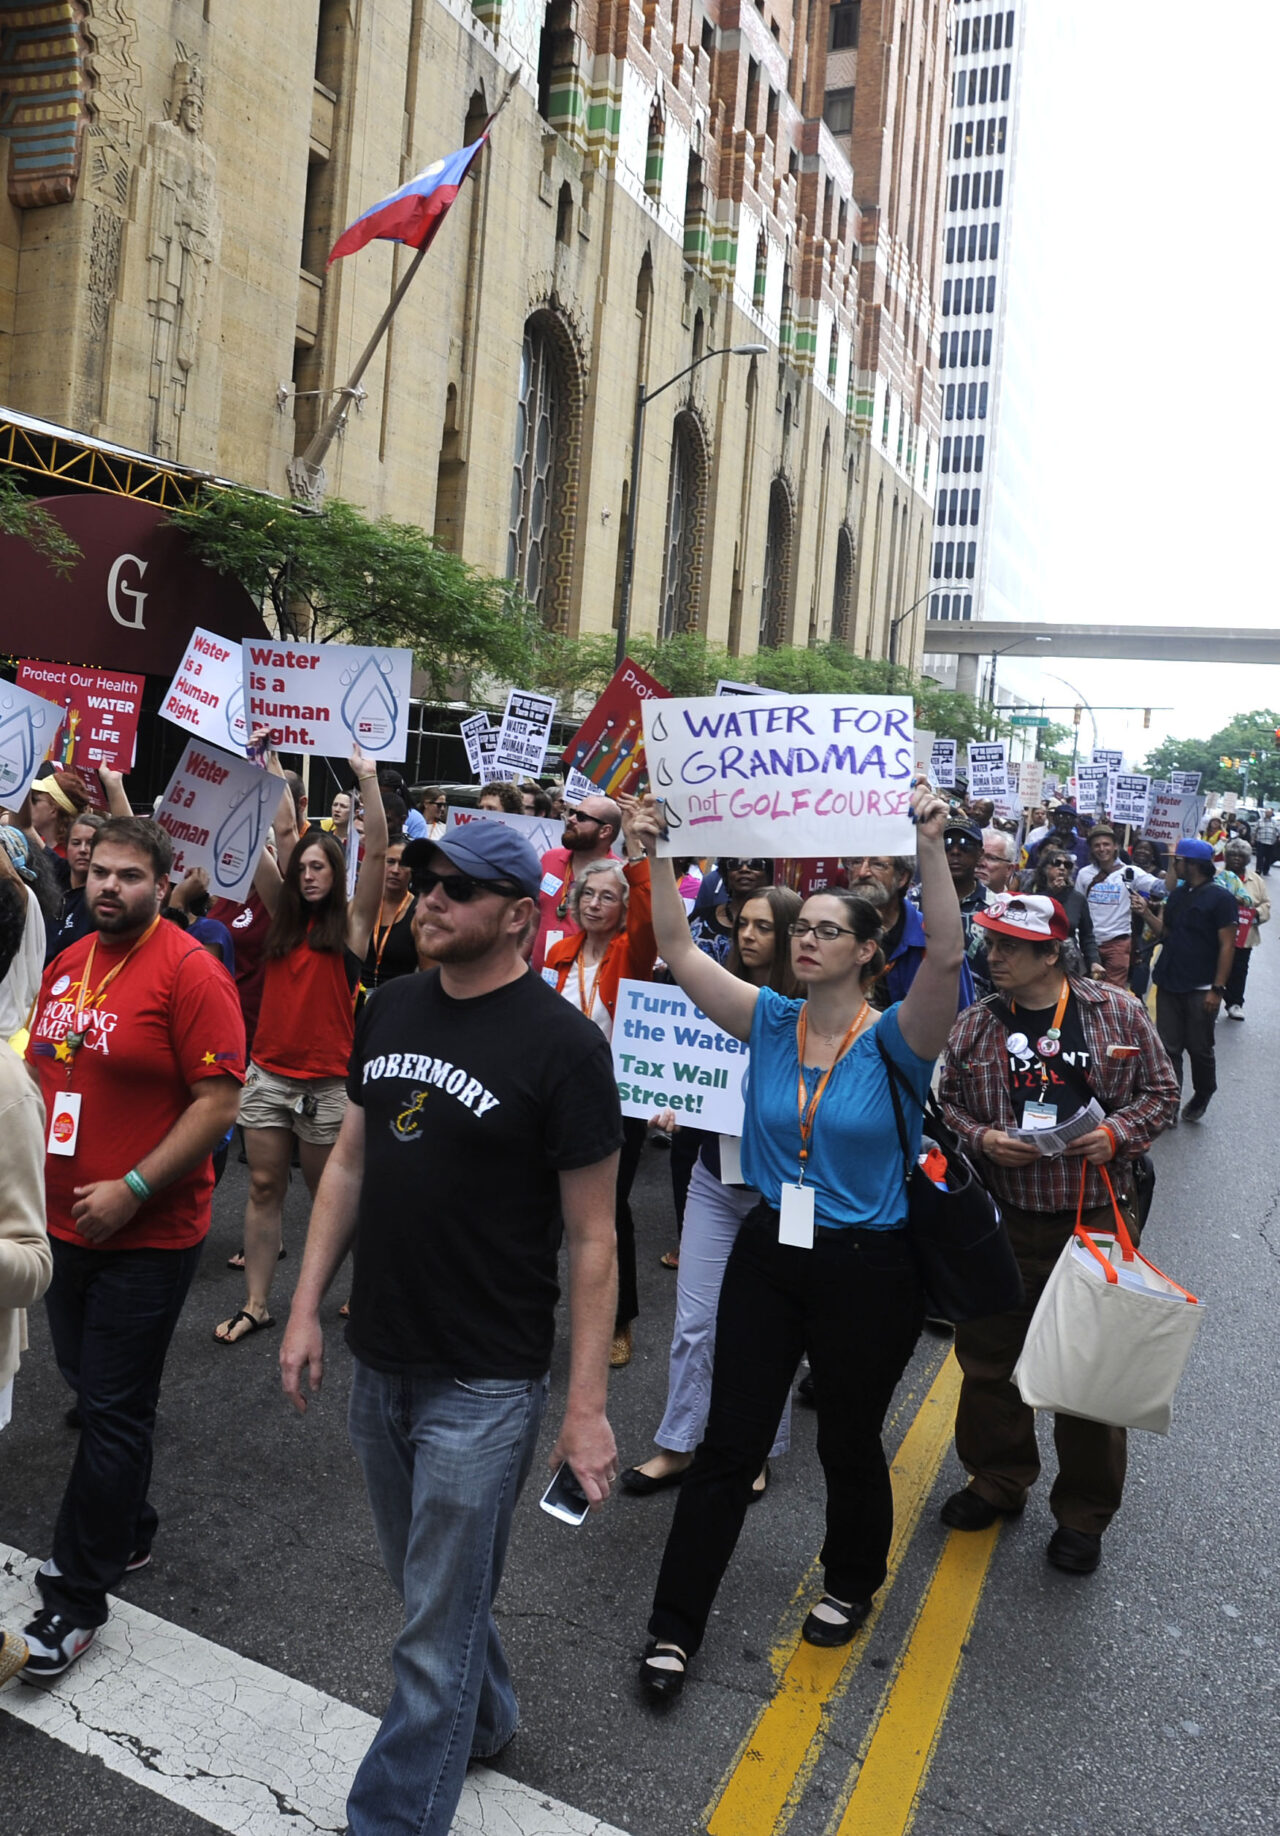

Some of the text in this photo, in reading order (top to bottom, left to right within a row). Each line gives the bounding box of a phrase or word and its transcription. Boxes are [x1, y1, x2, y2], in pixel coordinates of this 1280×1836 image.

[107, 553, 149, 630] G
[193, 635, 230, 662] Water
[250, 647, 320, 670] Water
[184, 655, 203, 676] is a
[22, 666, 138, 695] Protect Our Health
[175, 676, 219, 708] Human
[250, 672, 285, 692] is a
[87, 695, 135, 714] WATER
[166, 696, 200, 725] Right.
[250, 698, 329, 721] Human
[506, 719, 528, 735] WATER
[683, 705, 913, 742] WATER FOR
[91, 728, 120, 743] LIFE
[501, 738, 525, 754] HUMAN
[525, 743, 542, 759] RIGHT
[185, 750, 230, 785] Water
[484, 770, 504, 782] HUMAN
[681, 744, 912, 785] GRANDMAS
[972, 764, 988, 772] WATER
[973, 776, 1004, 786] HUMAN RIGHT
[1080, 782, 1094, 790] WATER
[168, 780, 196, 808] is a
[689, 789, 727, 813] not
[1156, 795, 1182, 806] Water
[1152, 807, 1160, 815] is
[159, 811, 209, 846] Human
[1145, 829, 1173, 840] Right.
[1149, 818, 1180, 829] Human
[628, 990, 687, 1017] Turn
[624, 1019, 665, 1042] the
[620, 1054, 728, 1089] Tax Wall
[362, 1053, 500, 1118] TOBERMORY
[617, 1082, 704, 1114] Street!
